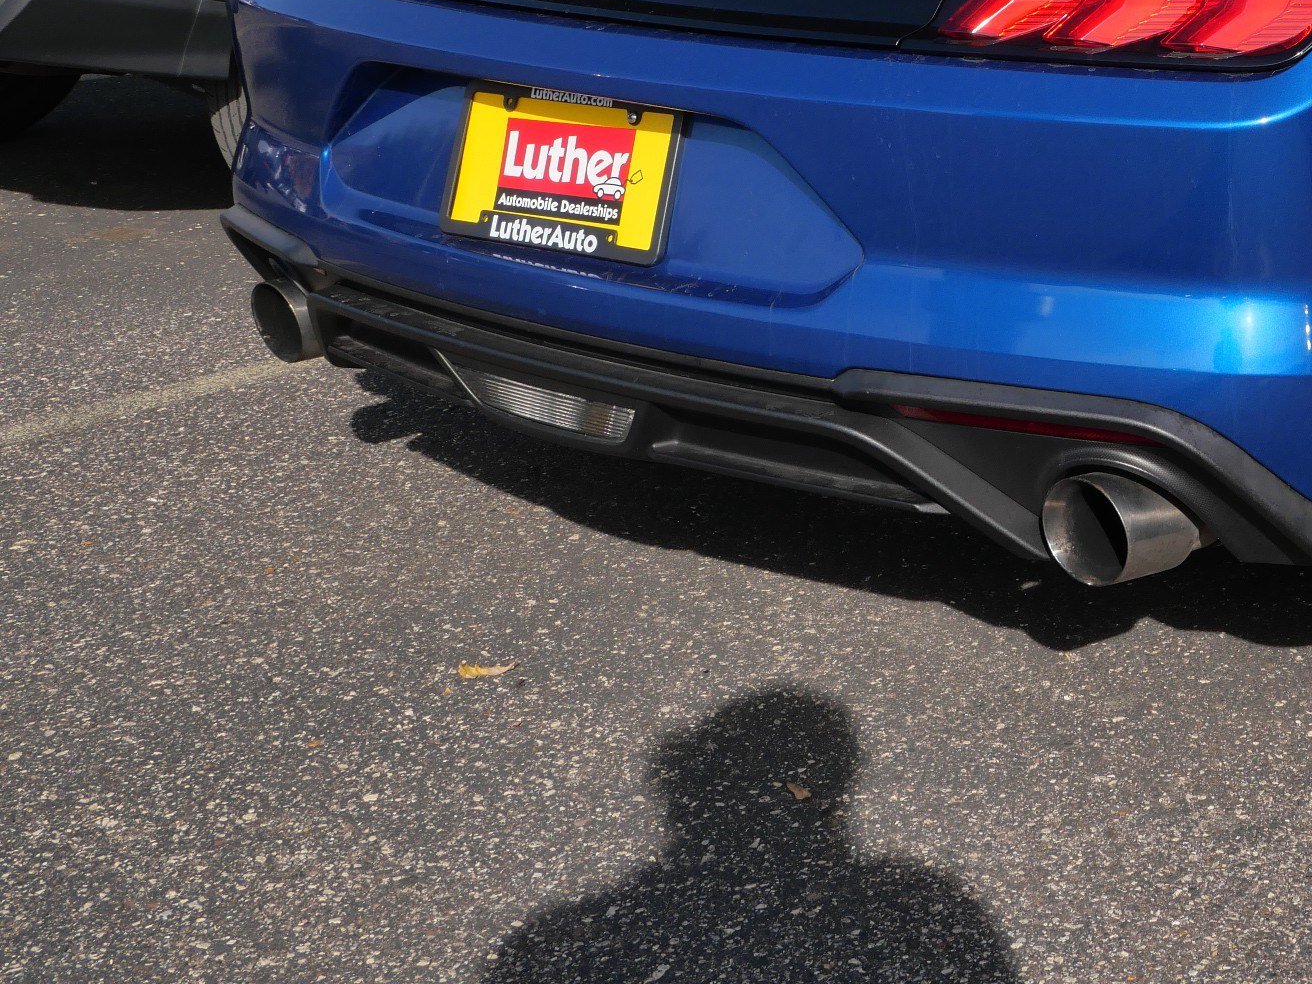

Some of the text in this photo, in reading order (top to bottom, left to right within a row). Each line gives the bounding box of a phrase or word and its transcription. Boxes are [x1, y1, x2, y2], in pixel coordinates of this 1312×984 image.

[530, 87, 613, 107] LutherAuto.com
[503, 130, 630, 186] Luther
[498, 193, 619, 221] Automobile Dealerships
[489, 214, 598, 253] LutherAuto
